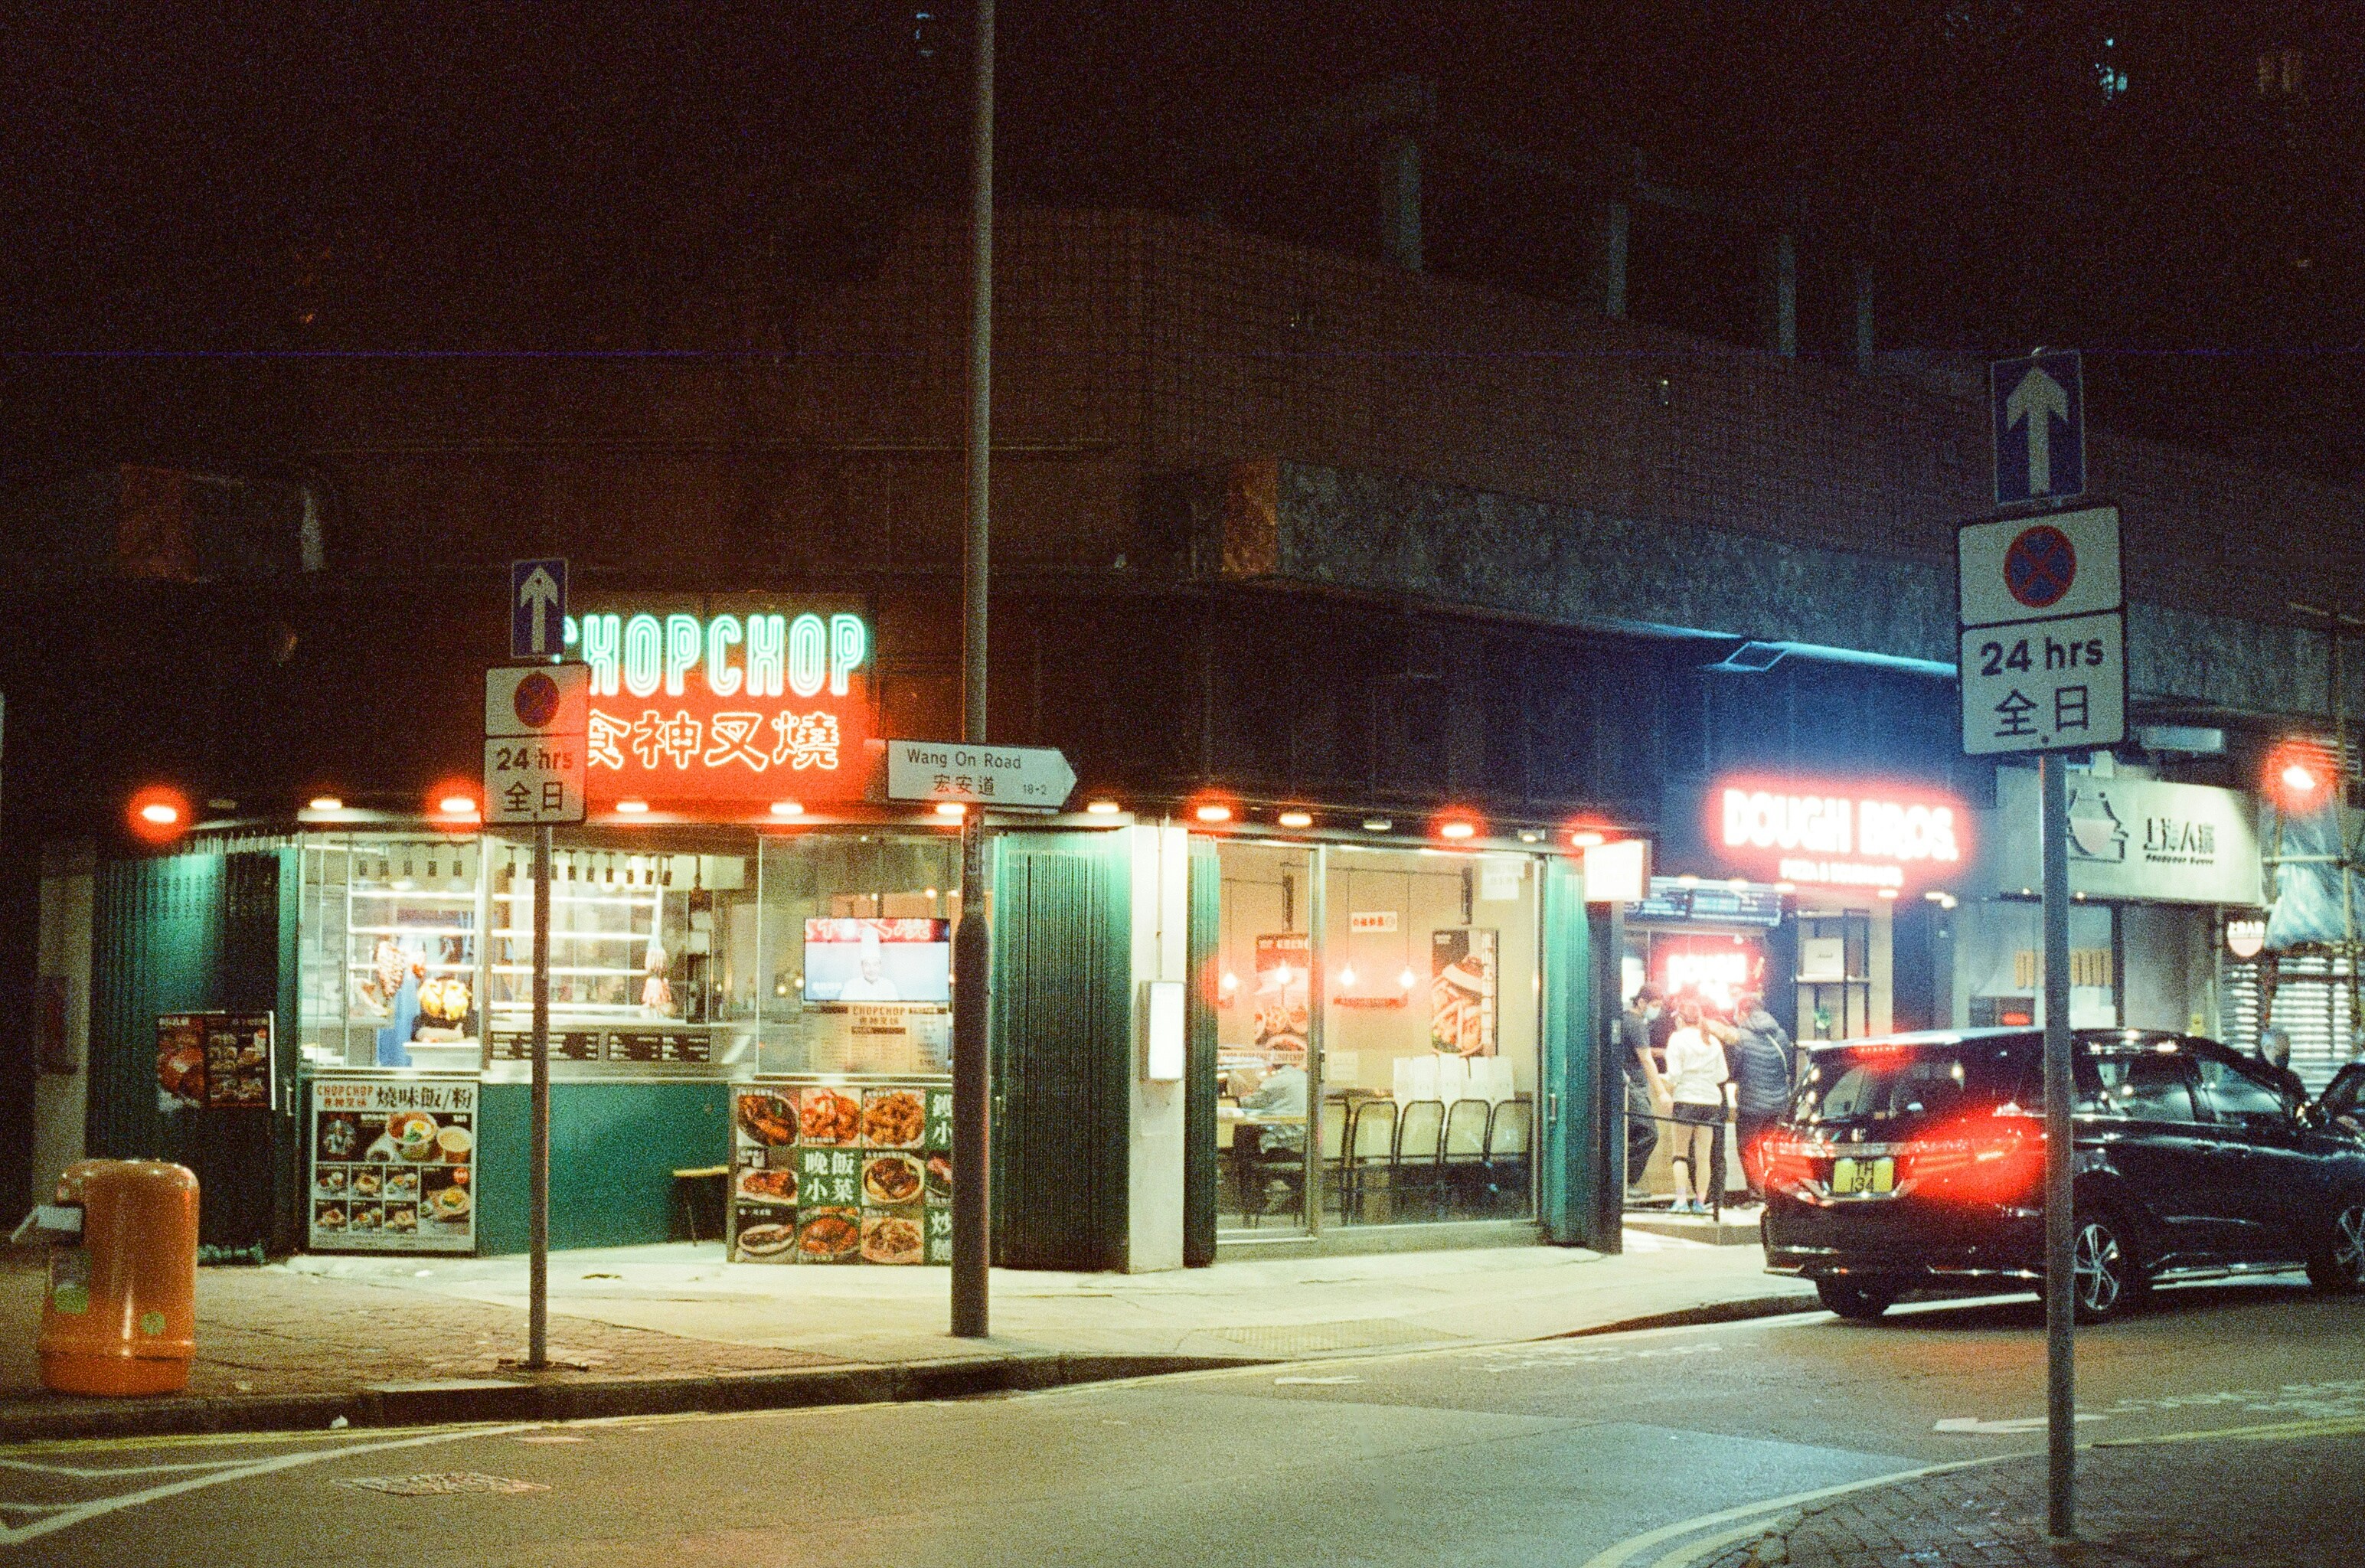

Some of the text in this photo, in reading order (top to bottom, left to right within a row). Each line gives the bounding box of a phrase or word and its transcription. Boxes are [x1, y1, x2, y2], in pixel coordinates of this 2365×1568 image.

[562, 613, 866, 697] HOPCHOP
[1980, 637, 2104, 677] 24 hrs
[1994, 686, 2089, 737] 全日
[497, 747, 573, 770] 24 hrs
[906, 749, 1021, 769] Wang On Road
[503, 781, 563, 812] 全日
[934, 774, 995, 796] 宏安道
[1723, 789, 1851, 853] DOUGH
[317, 1085, 374, 1096] CHOPCHOP
[805, 1152, 854, 1175] 晚飯
[804, 1178, 854, 1202] 小菜
